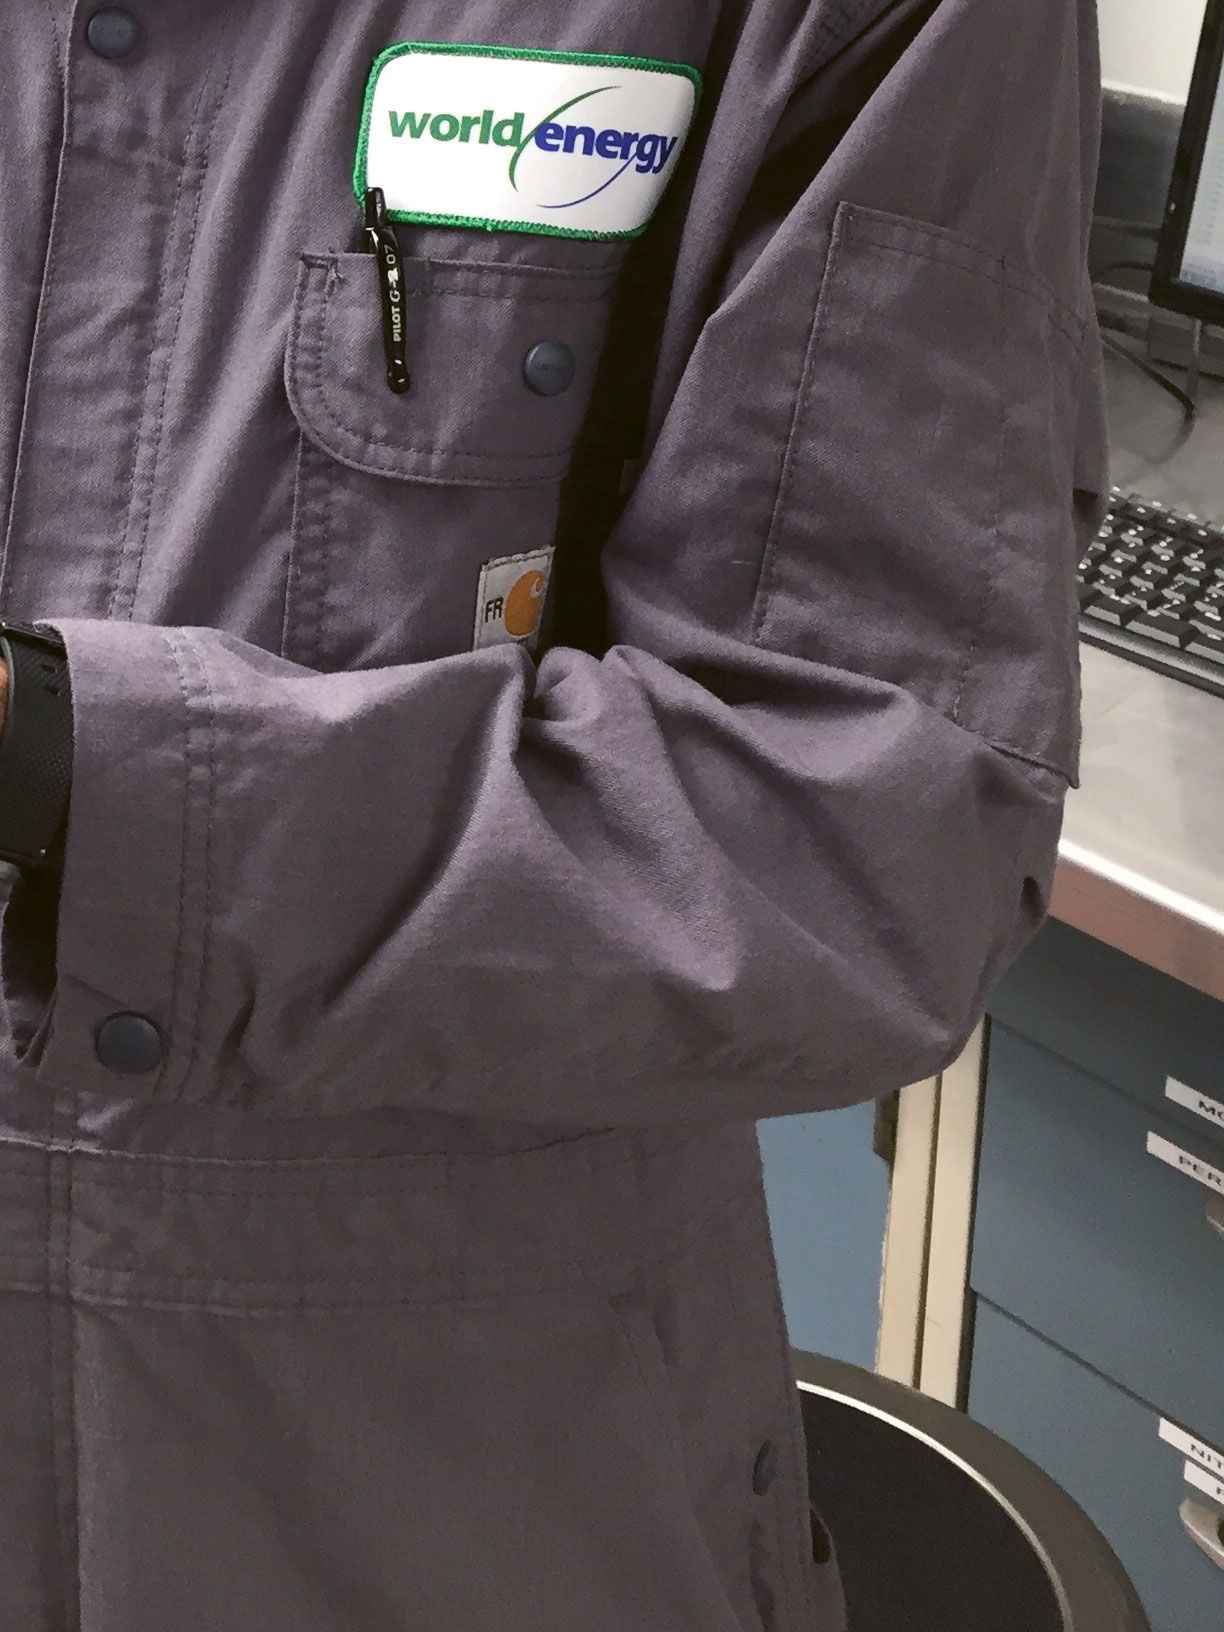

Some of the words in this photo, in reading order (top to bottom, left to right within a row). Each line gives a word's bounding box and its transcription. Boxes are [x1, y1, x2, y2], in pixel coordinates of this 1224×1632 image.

[388, 109, 525, 148] world
[534, 122, 678, 174] energy
[391, 305, 402, 342] PILOT
[485, 597, 504, 623] FR
